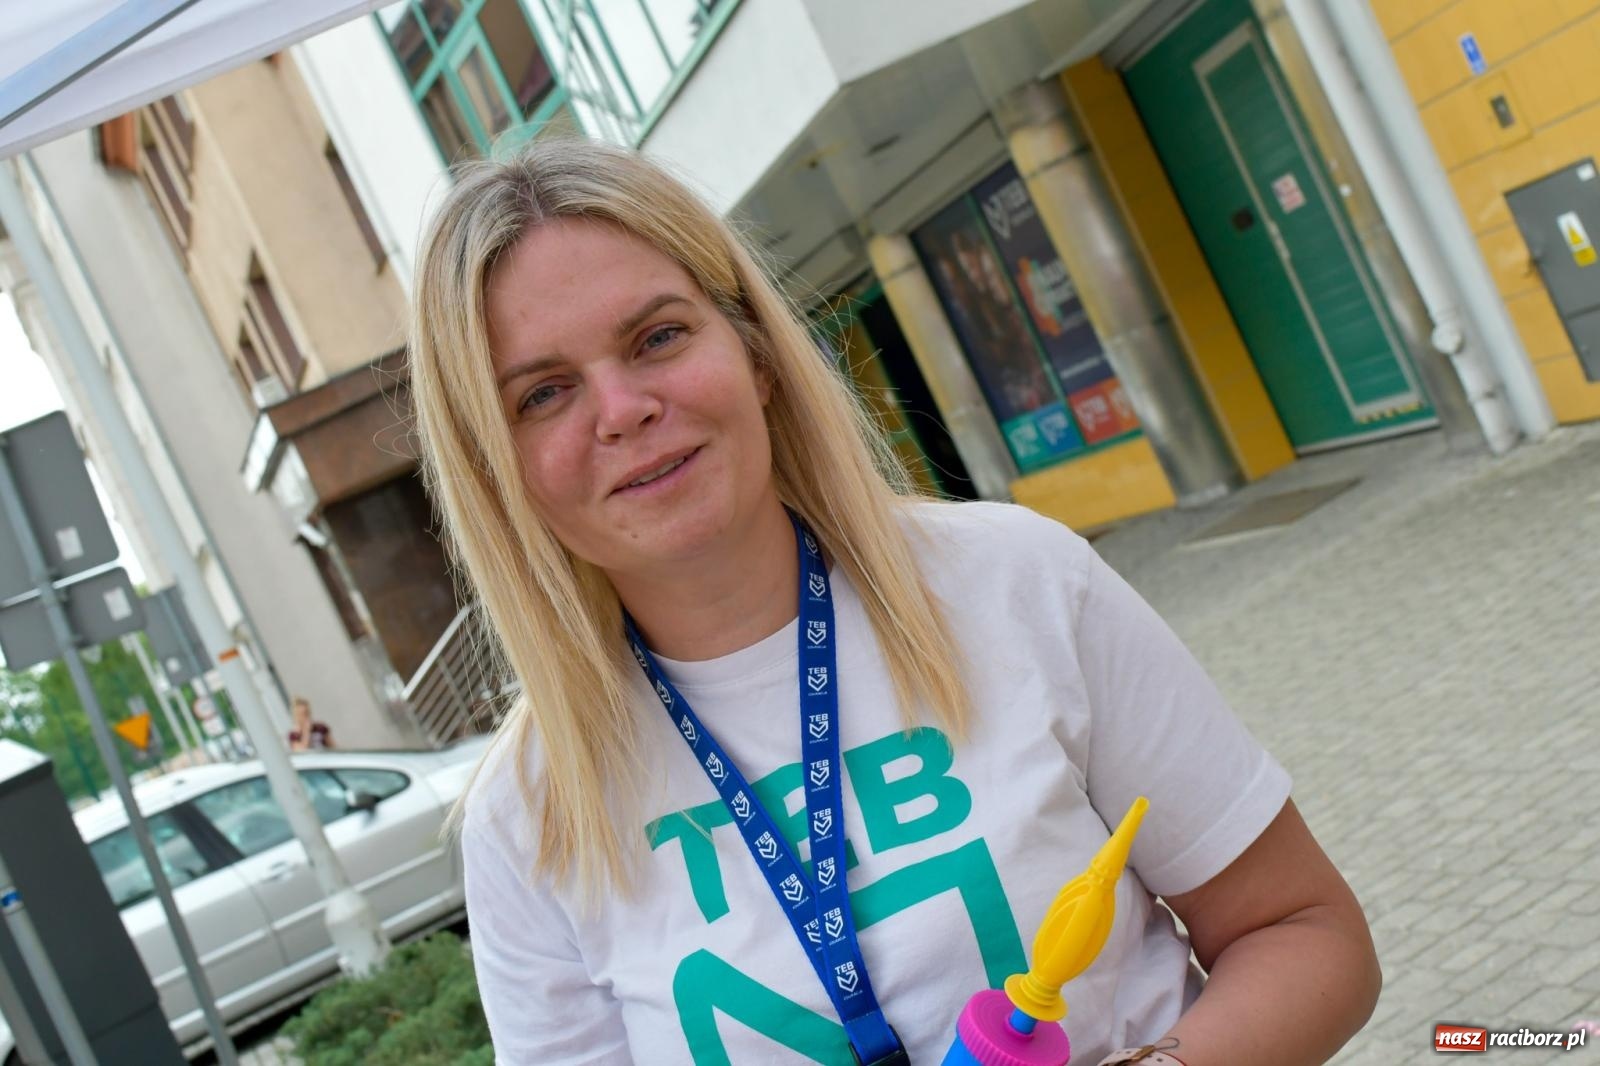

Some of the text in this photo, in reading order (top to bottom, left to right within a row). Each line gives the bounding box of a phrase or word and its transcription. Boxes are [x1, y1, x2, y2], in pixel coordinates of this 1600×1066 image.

[809, 572, 824, 583] TEB
[809, 713, 828, 722] TEB
[705, 752, 717, 768] TEB
[810, 759, 829, 770] TEB
[730, 790, 745, 808] TEB
[813, 807, 832, 819] TEB
[644, 726, 973, 924] TEB
[754, 831, 771, 848] TEB
[817, 857, 835, 869] TEB
[779, 873, 798, 890] TEB
[823, 907, 842, 921] TEB
[803, 918, 819, 932] TE
[834, 961, 855, 975] TEB
